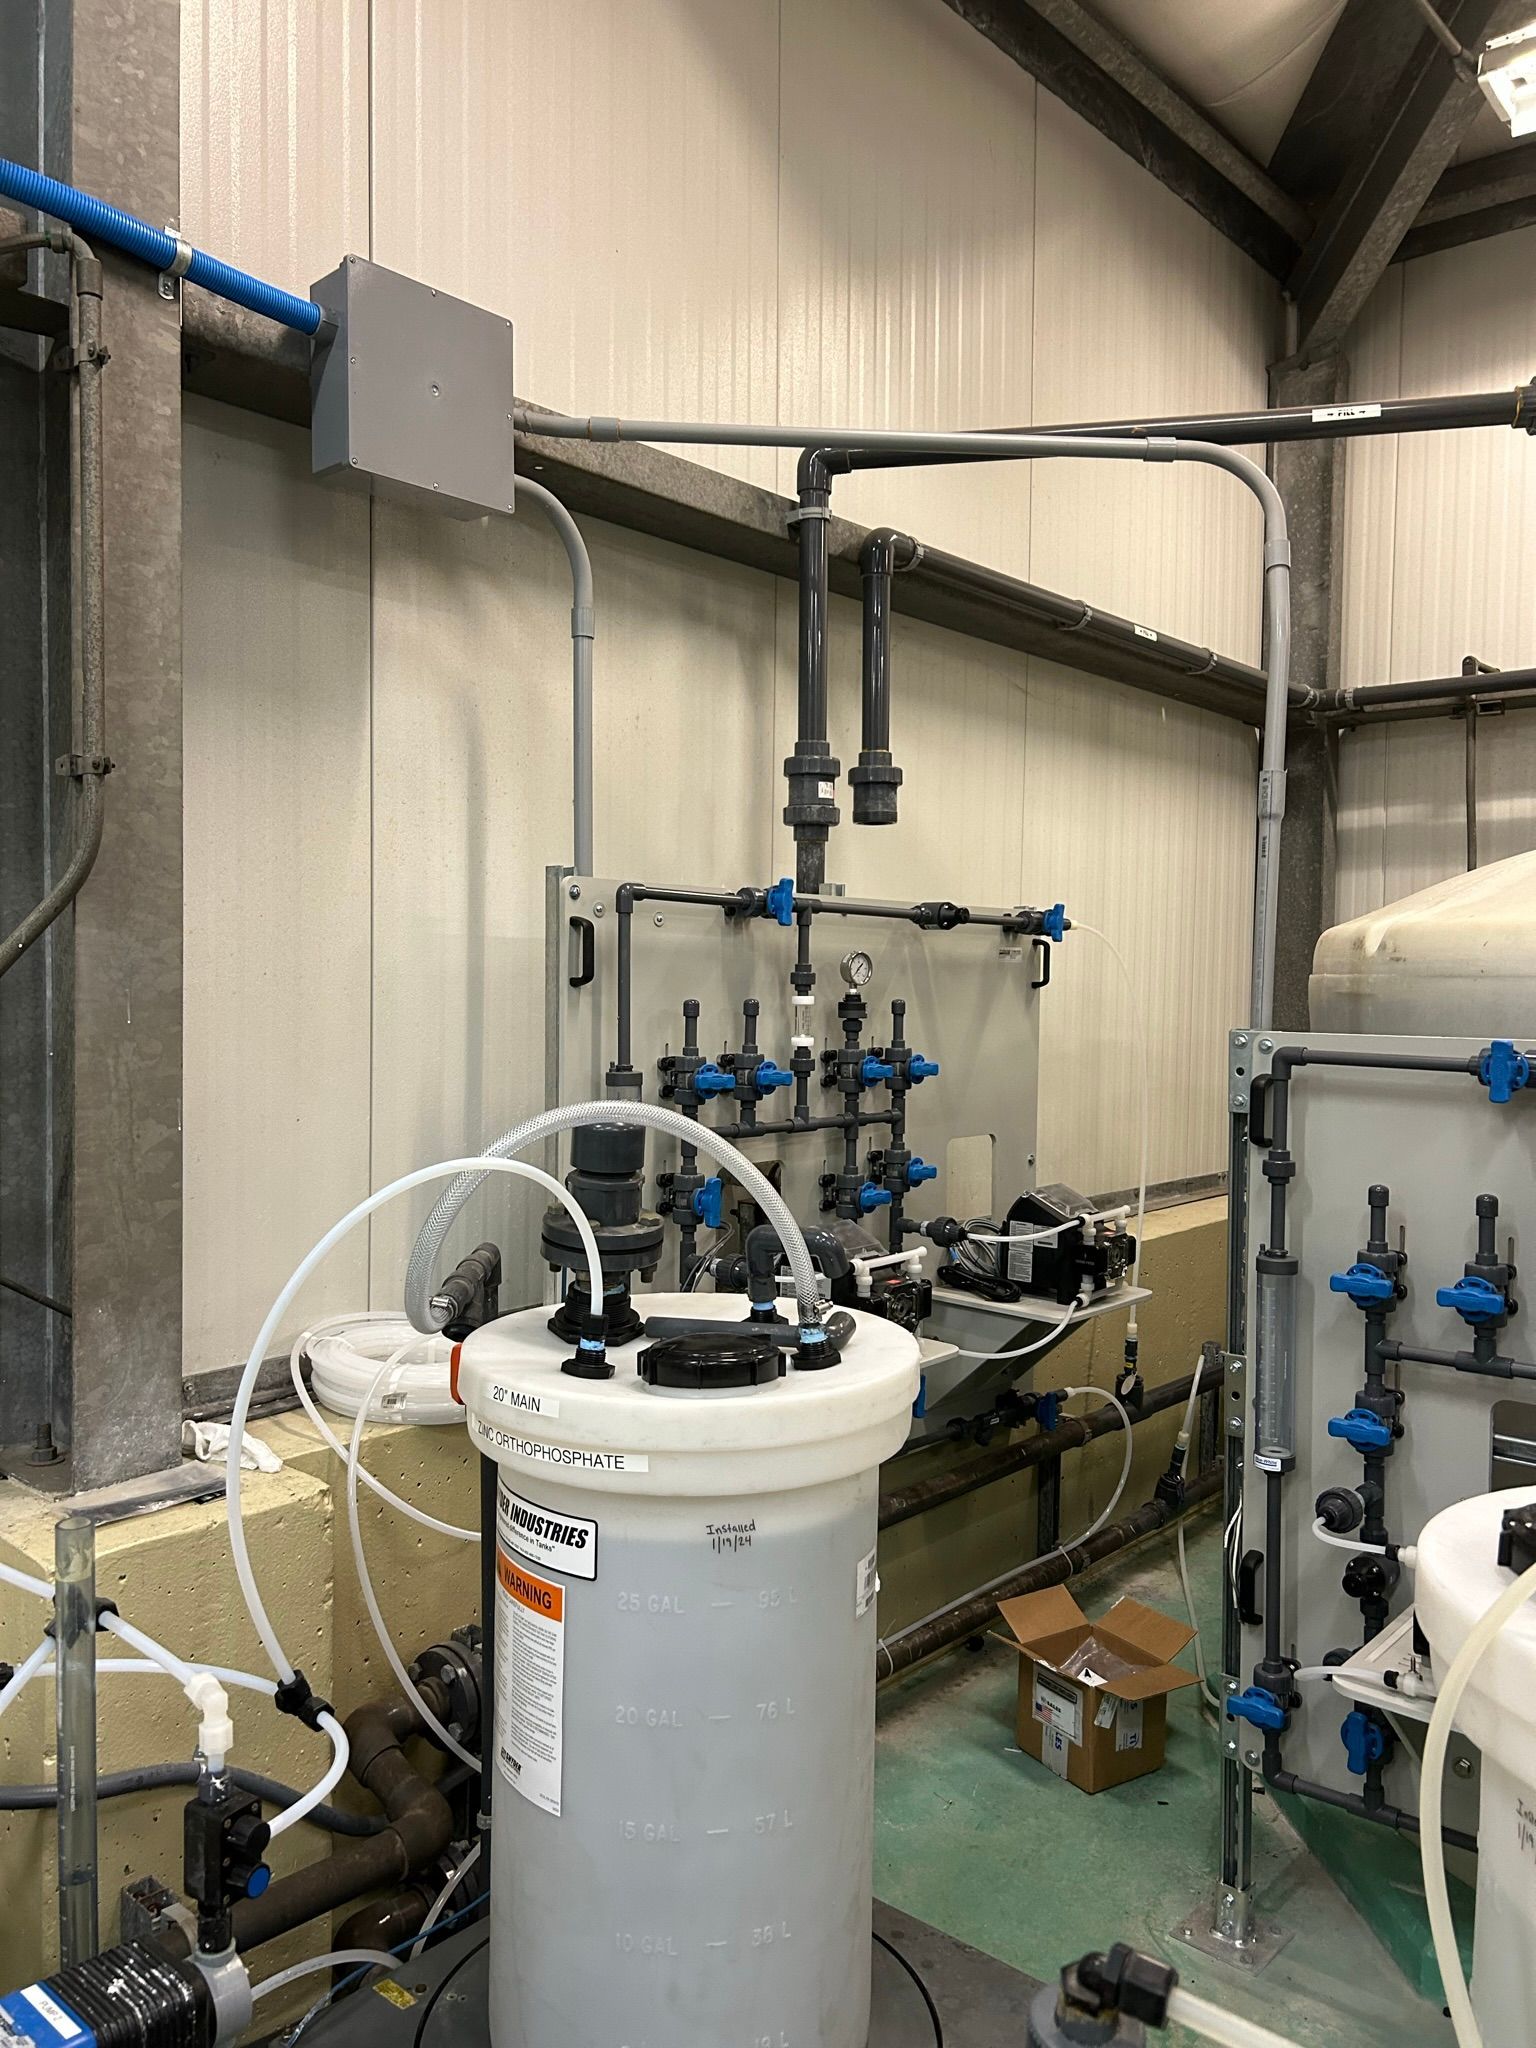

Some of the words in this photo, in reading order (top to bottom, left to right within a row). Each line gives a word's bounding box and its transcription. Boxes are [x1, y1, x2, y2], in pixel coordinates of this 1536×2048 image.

[493, 1385, 508, 1402] 20"
[510, 1391, 541, 1413] MAIN
[477, 1420, 494, 1441] ZINC
[495, 1431, 625, 1470] ORTHOPHOSPHATE
[510, 1503, 589, 1549] INDUSTRIES
[705, 1519, 756, 1535] Installed
[712, 1535, 752, 1554] 1/19/24
[504, 1565, 552, 1610] WARNING
[617, 1591, 640, 1611] 25
[647, 1595, 685, 1614] GAL
[615, 1705, 638, 1725] 20
[646, 1708, 683, 1727] GAL
[756, 1701, 778, 1720] 76
[786, 1697, 795, 1715] L
[619, 1820, 636, 1839] 15
[643, 1823, 681, 1842] GAL
[754, 1813, 776, 1834] 57
[784, 1809, 793, 1828] L
[616, 1932, 633, 1952] 10
[640, 1935, 678, 1955] GAL
[751, 1925, 773, 1947] 38
[782, 1921, 791, 1938] L
